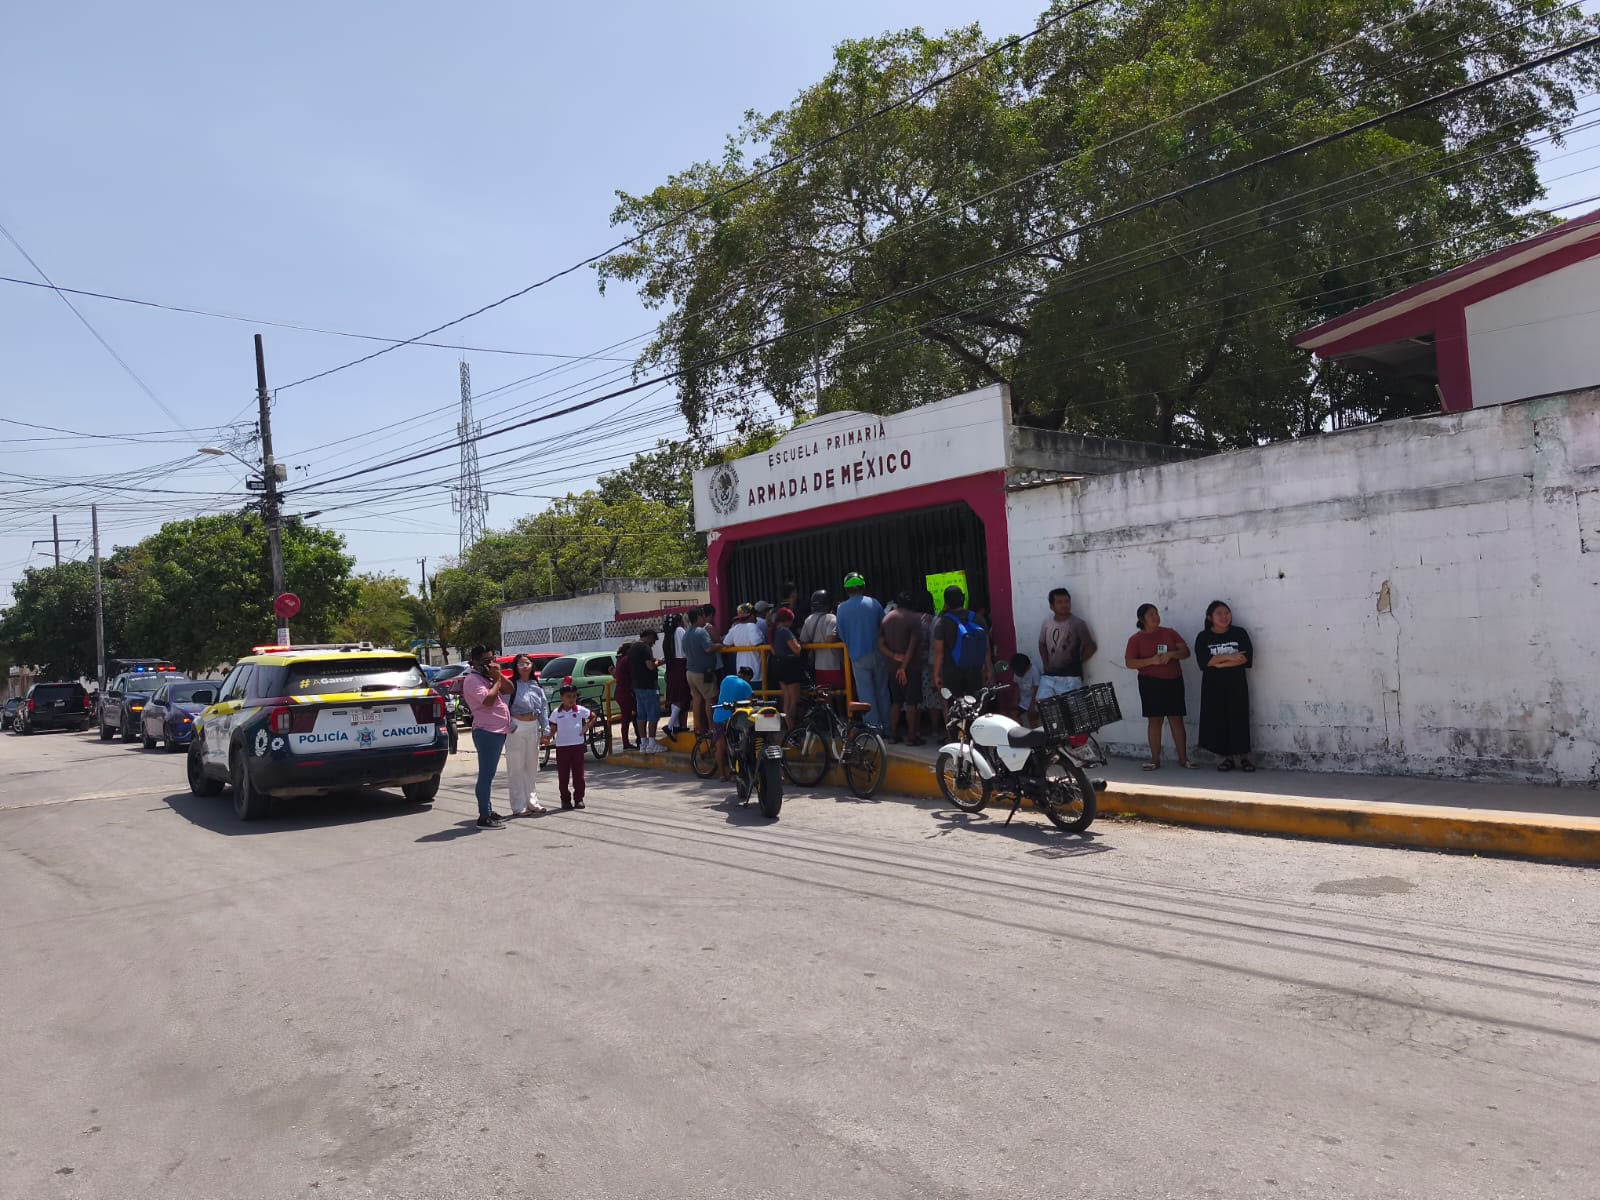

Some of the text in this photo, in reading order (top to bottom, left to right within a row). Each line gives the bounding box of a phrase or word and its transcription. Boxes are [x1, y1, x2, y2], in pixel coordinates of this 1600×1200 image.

[768, 422, 886, 467] ESCUELA PRIMARIA
[748, 475, 808, 507] ARMADA
[813, 468, 835, 491] DE
[841, 449, 912, 484] MÉXICO
[299, 724, 428, 744] POLICÍA CANCÚN
